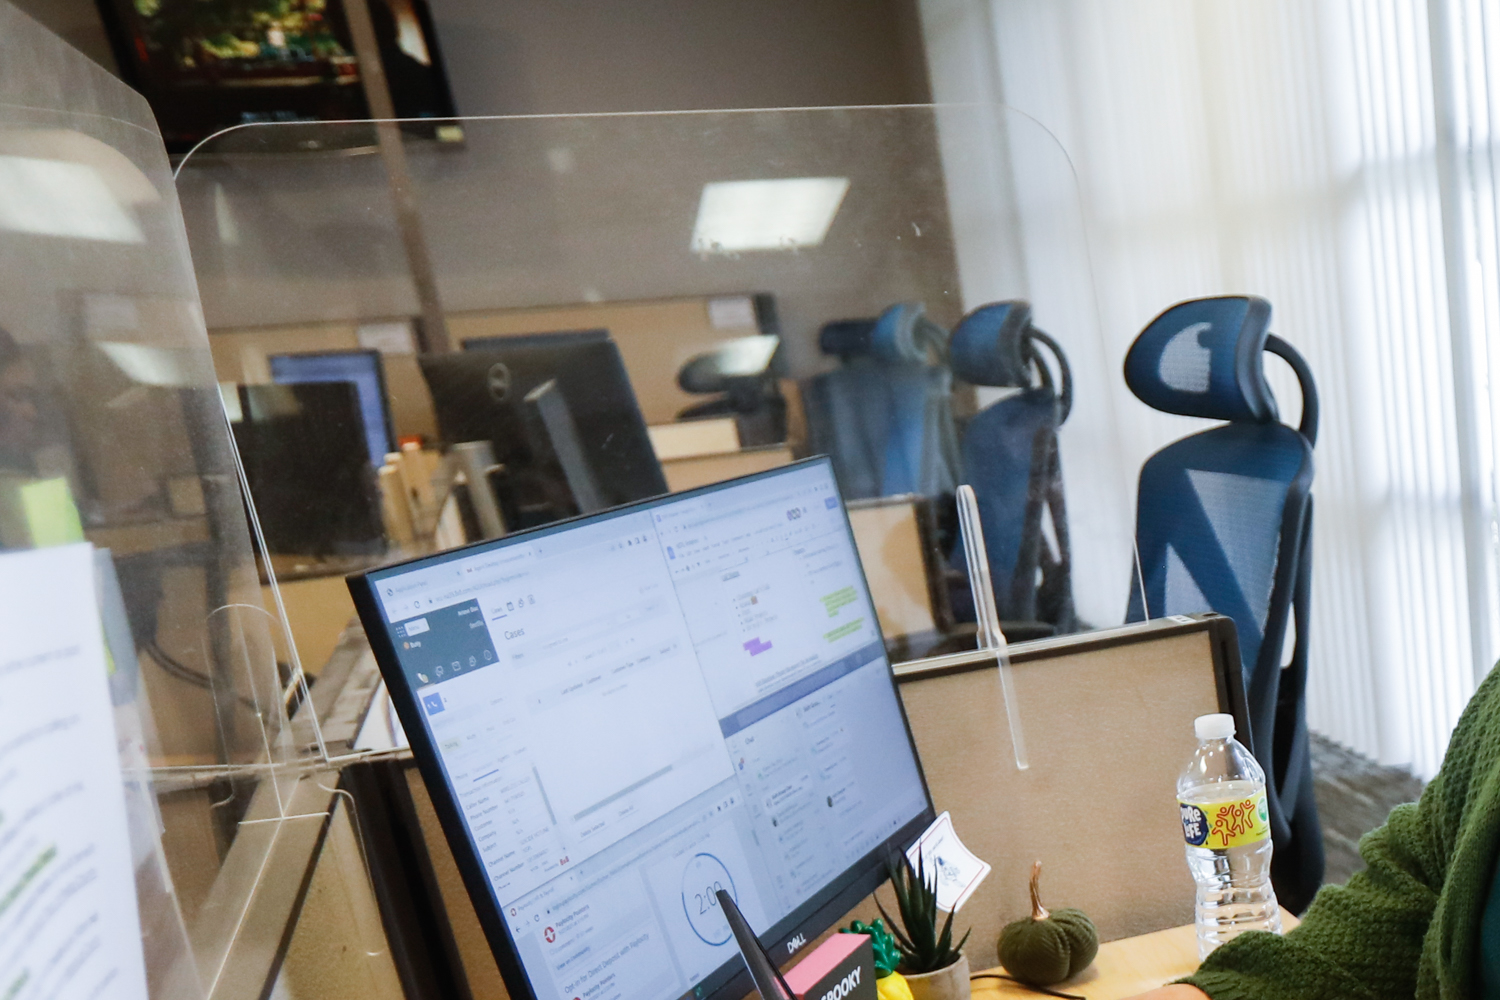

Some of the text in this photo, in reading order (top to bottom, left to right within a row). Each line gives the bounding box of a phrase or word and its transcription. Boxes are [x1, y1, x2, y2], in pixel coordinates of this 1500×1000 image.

[503, 626, 525, 640] Cases
[787, 932, 806, 954] DELL
[587, 963, 602, 978] Direct
[602, 951, 620, 969] Deposit
[619, 944, 630, 956] with
[629, 931, 650, 950] Paylocity
[582, 982, 600, 999] Paylocity
